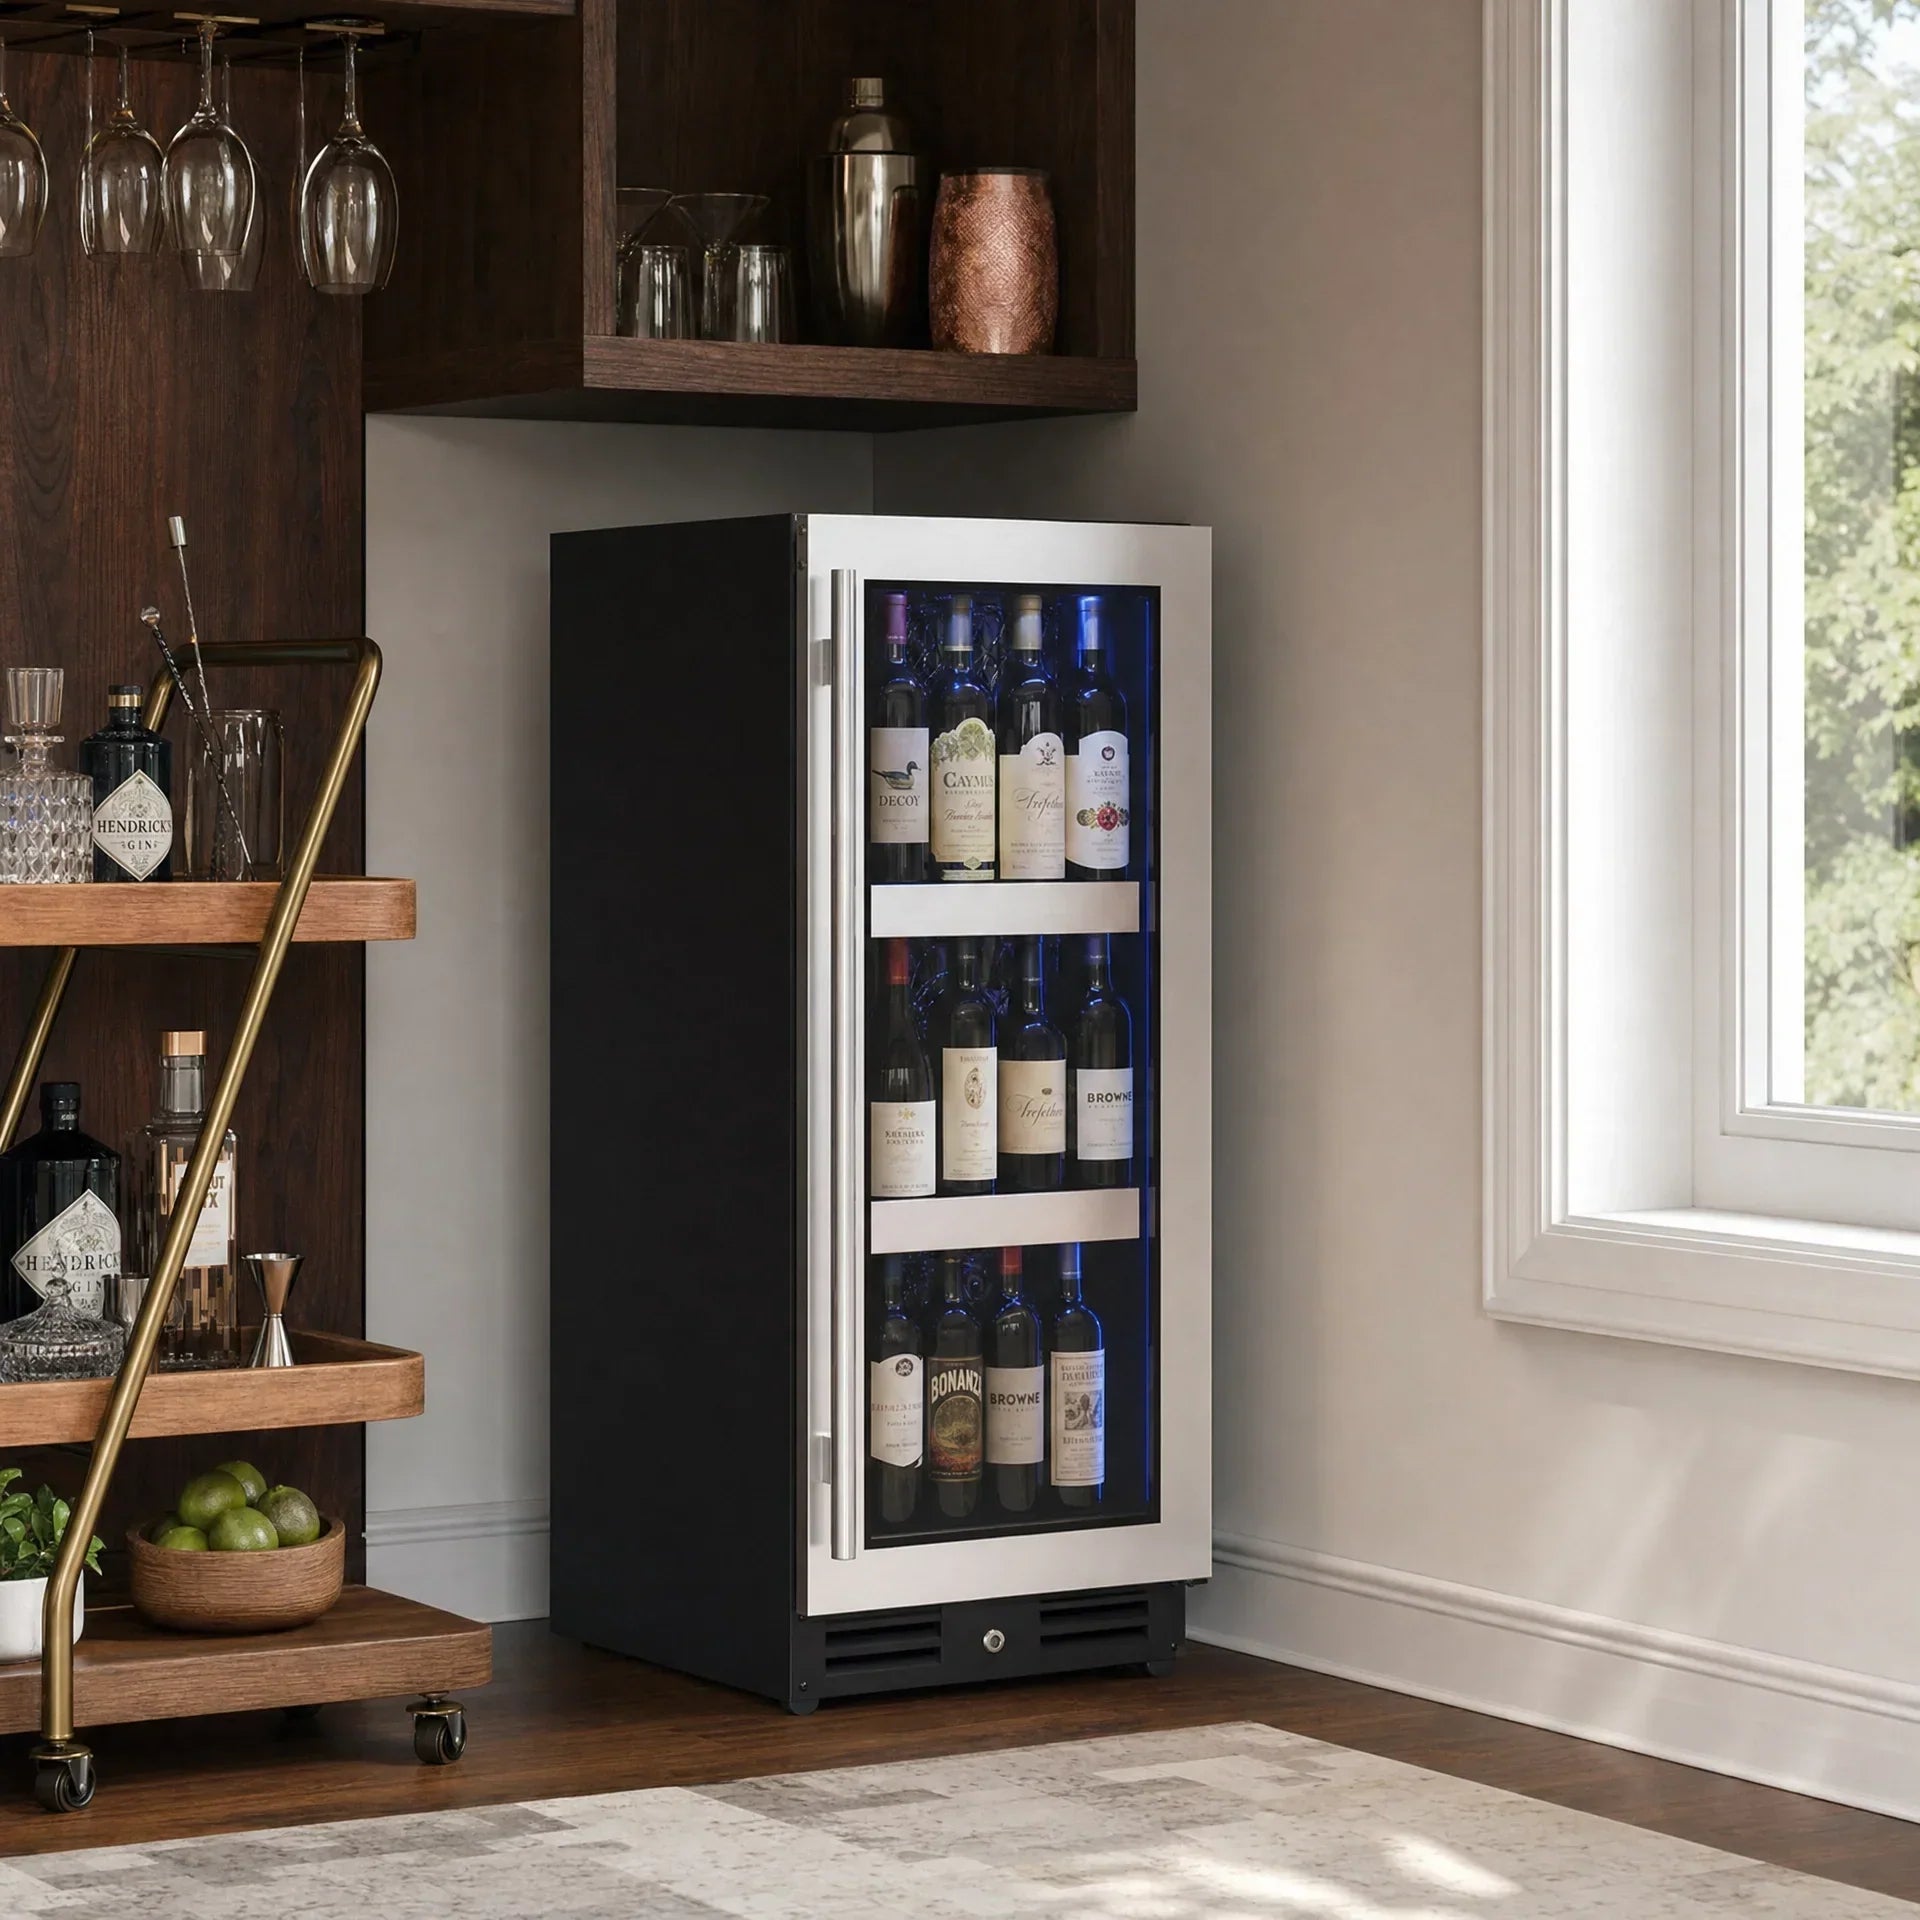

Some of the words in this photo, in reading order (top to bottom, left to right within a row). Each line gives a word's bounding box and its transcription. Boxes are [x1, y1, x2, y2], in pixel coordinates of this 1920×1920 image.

[879, 795, 920, 807] DECOY
[127, 840, 151, 850] GIN
[1087, 1091, 1132, 1103] BROWNE
[72, 1280, 101, 1293] GIN
[990, 1391, 1040, 1405] BROWNE
